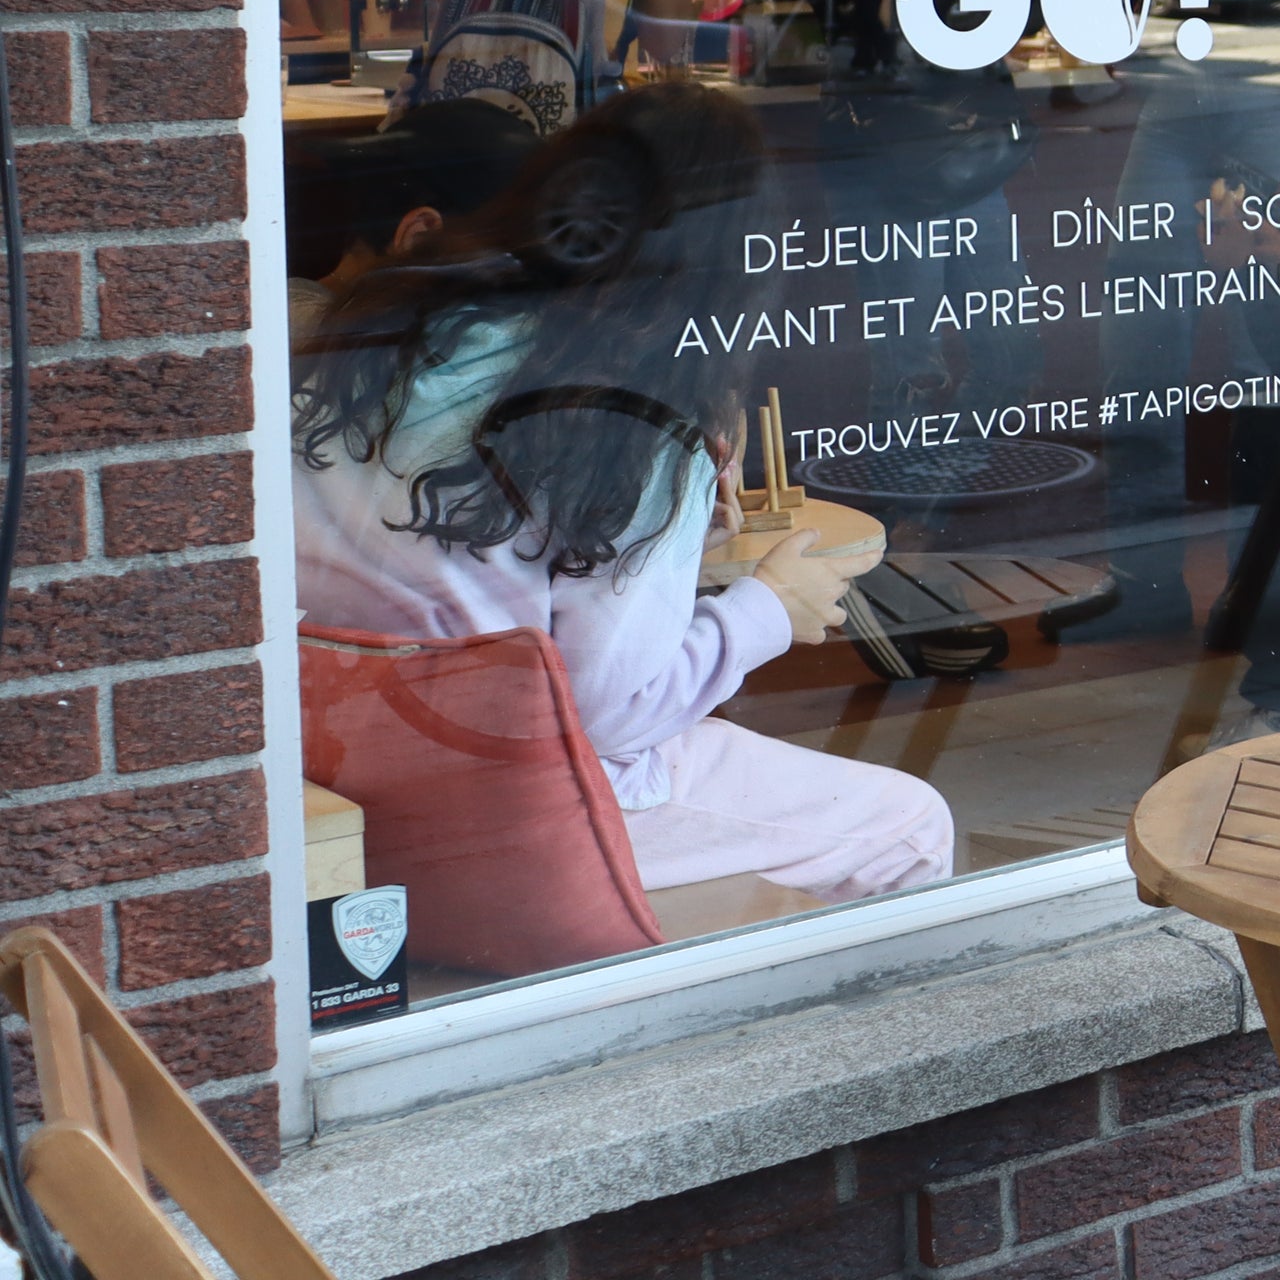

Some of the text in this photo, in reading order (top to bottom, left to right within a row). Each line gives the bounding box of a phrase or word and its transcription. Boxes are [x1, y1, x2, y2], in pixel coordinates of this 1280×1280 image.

[743, 217, 978, 275] DÉJEUNER
[1052, 197, 1175, 249] DÎNER
[673, 303, 847, 359] AVANT
[863, 297, 916, 340] ET
[929, 278, 1065, 334] APRÈS
[791, 413, 961, 463] TROUVEZ
[971, 397, 1089, 441] VOTRE
[343, 920, 404, 939] GARDAWORLD
[312, 982, 400, 1010] 1 833 GARDA 33
